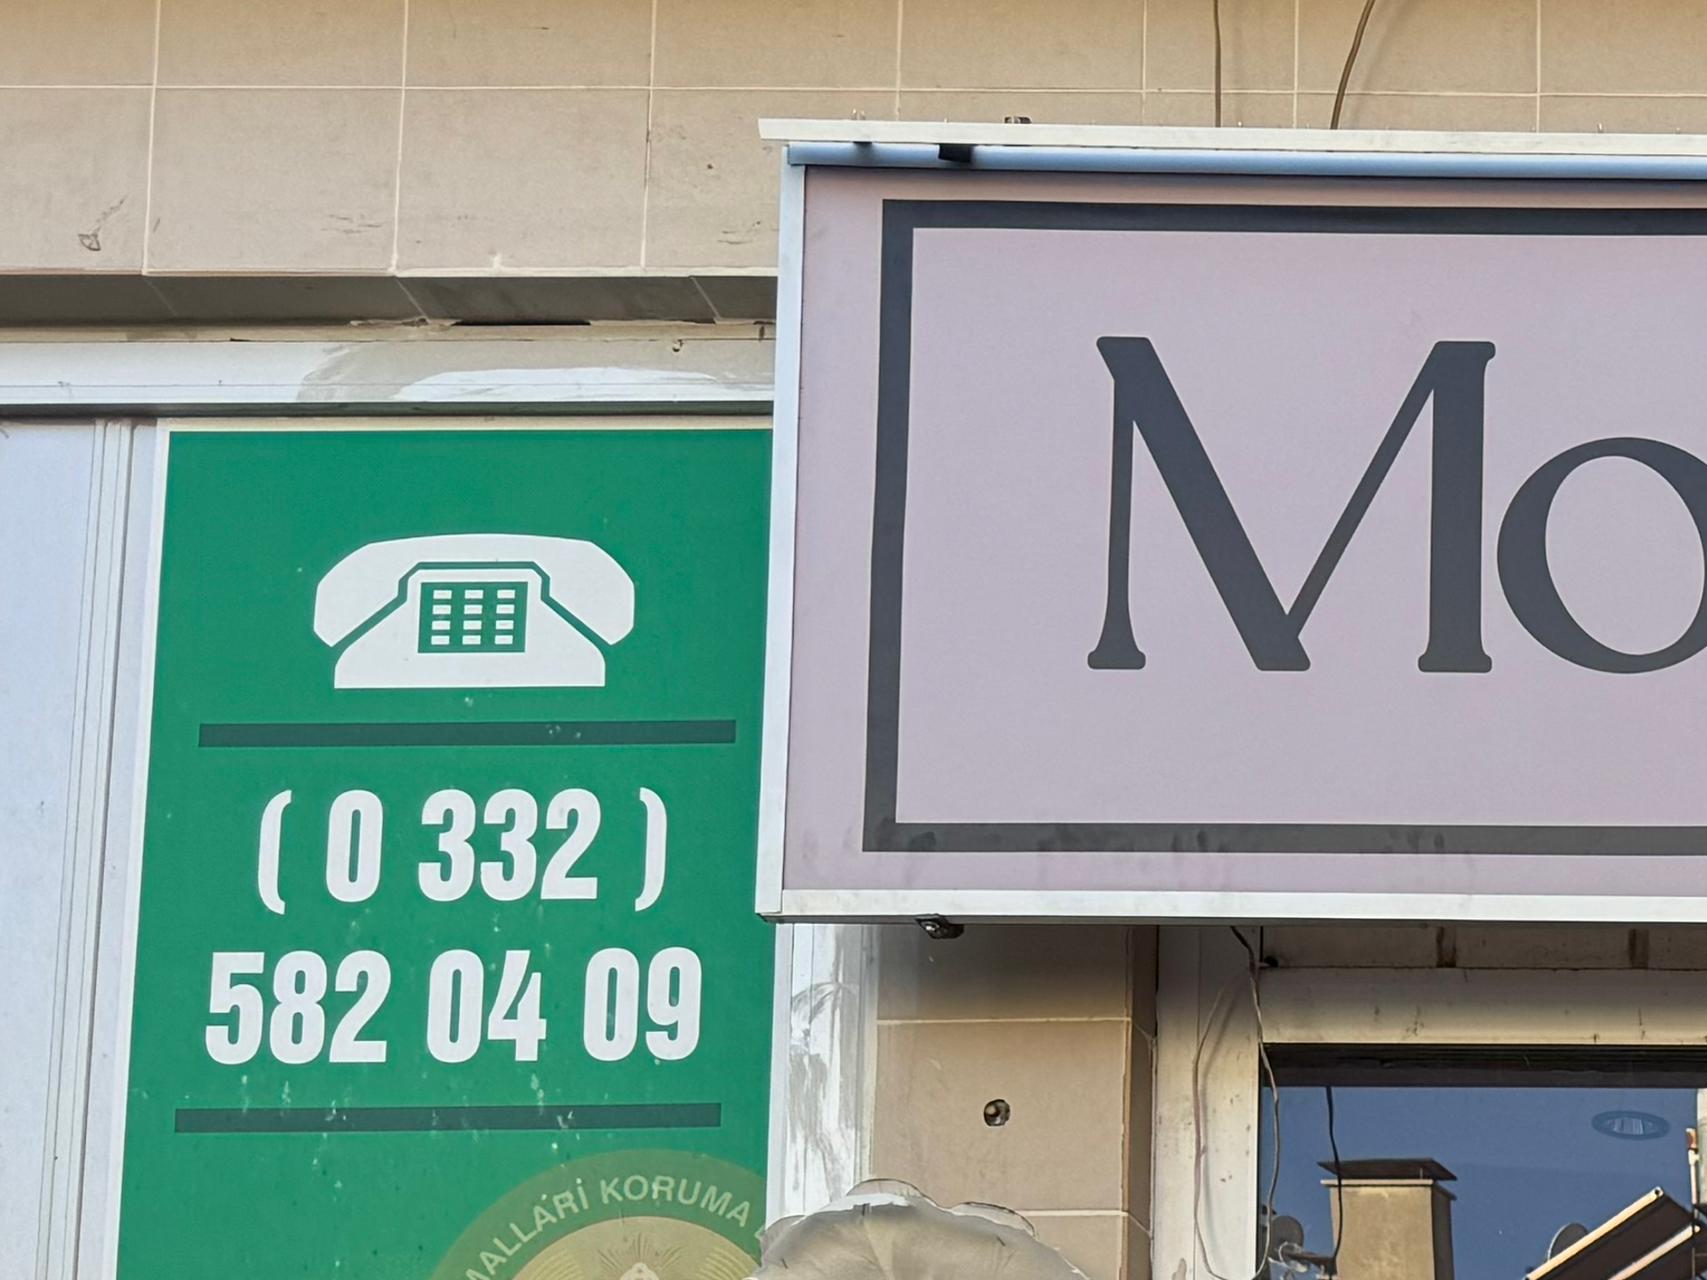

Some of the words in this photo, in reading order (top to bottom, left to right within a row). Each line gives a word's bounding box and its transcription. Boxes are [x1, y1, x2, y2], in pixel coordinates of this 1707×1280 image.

[205, 950, 391, 1065] 582
[427, 947, 546, 1061] 04
[583, 946, 701, 1060] 09
[600, 1174, 751, 1227] KORUMA
